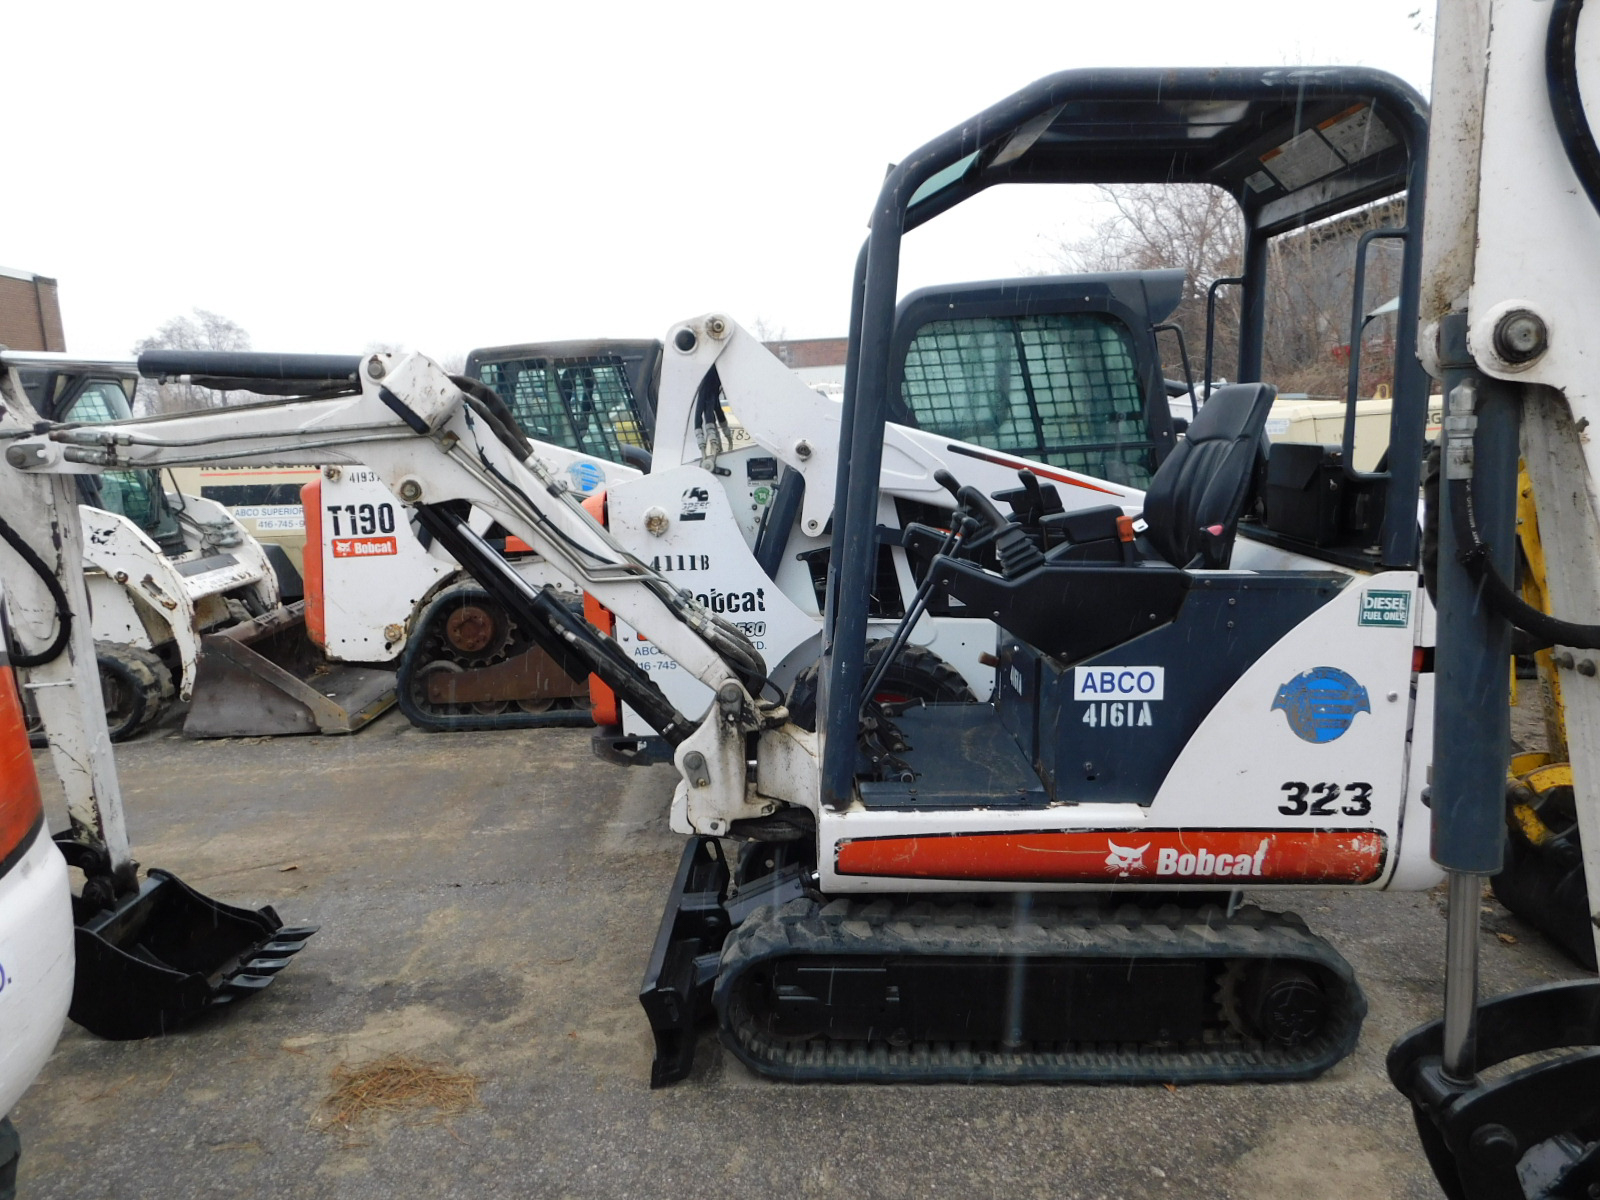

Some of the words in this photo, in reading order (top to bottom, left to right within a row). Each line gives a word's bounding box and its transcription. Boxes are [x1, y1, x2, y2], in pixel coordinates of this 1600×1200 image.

[235, 509, 260, 517] ABCO
[327, 503, 396, 536] T190
[353, 541, 393, 554] Bobcat
[651, 554, 710, 572] 4111B
[689, 587, 766, 614] obcat
[1364, 597, 1407, 610] DIESEL
[1363, 611, 1382, 620] FUEL
[1383, 612, 1406, 621] ONLY
[731, 620, 767, 637] 530
[638, 660, 677, 671] 16-745
[1081, 671, 1155, 694] ABCO
[1082, 701, 1153, 728] 4161A
[1278, 781, 1373, 816] 323
[1156, 837, 1269, 876] Bobcat
